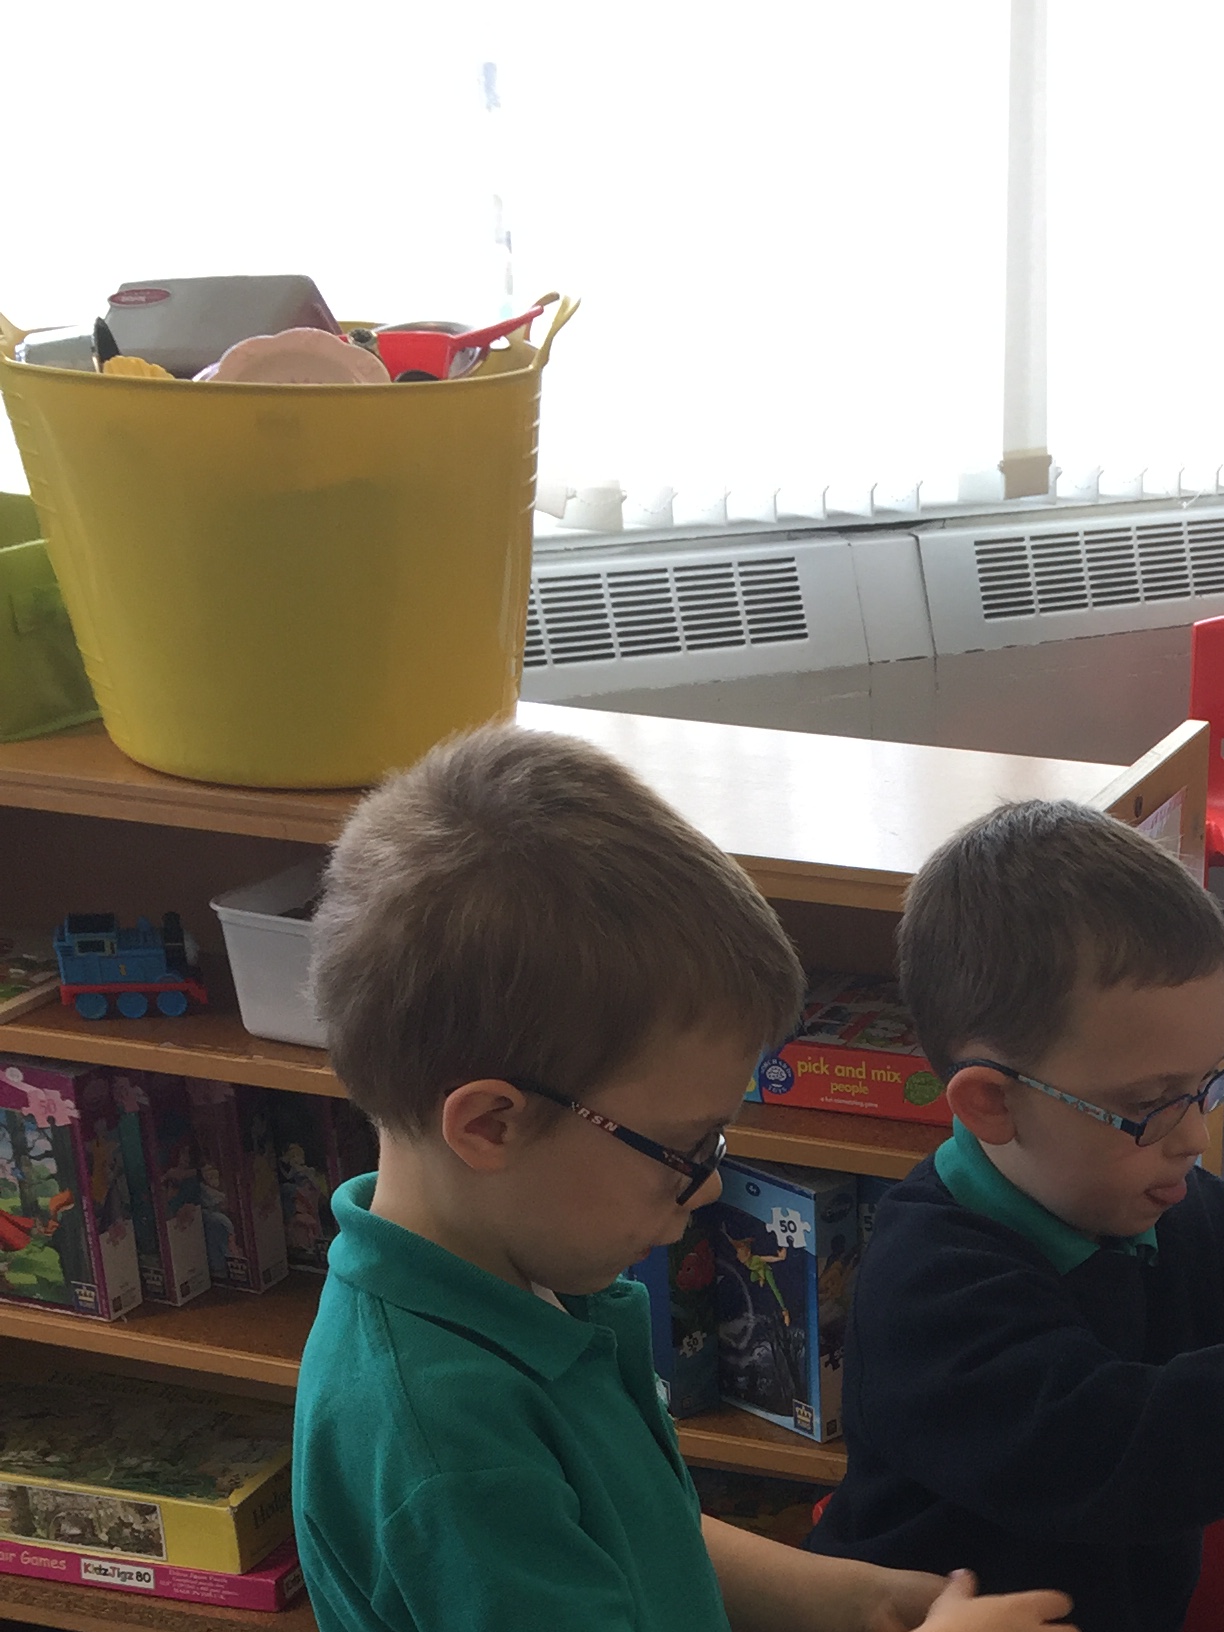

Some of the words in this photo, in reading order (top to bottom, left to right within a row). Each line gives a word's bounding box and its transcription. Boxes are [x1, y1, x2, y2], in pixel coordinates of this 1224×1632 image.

[797, 1056, 830, 1077] pick
[834, 1061, 866, 1080] and
[871, 1065, 903, 1084] mix
[830, 1081, 870, 1097] people
[39, 1098, 57, 1115] 50
[779, 1219, 798, 1235] 50
[863, 1215, 873, 1232] 5
[686, 1336, 699, 1351] 50
[20, 1550, 67, 1571] Games
[135, 1570, 152, 1583] 80
